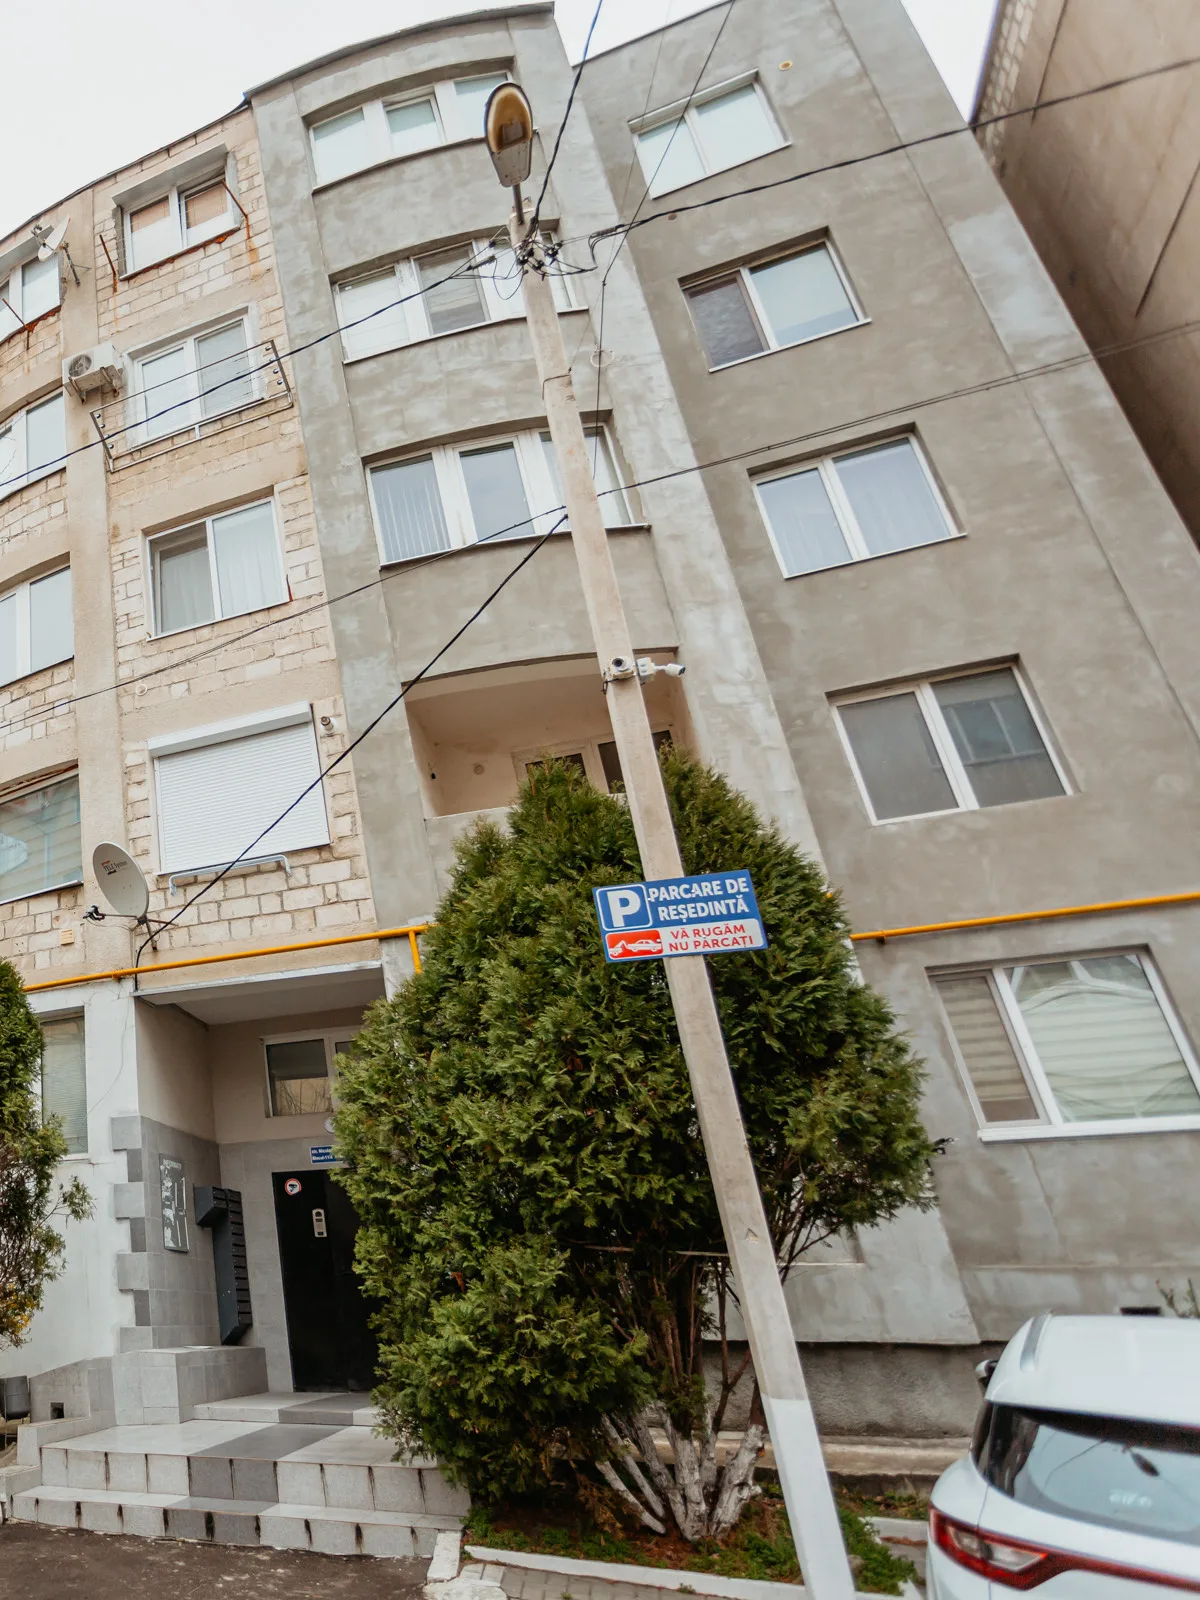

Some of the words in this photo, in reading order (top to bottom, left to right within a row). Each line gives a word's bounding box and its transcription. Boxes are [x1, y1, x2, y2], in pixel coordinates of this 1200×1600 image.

[648, 880, 724, 902] PARCARE
[725, 877, 750, 894] DE
[606, 889, 641, 928] P
[670, 927, 690, 940] VĂ
[692, 923, 746, 938] RUGĂM
[669, 940, 689, 952] NU
[693, 936, 753, 949] PARCAȚI
